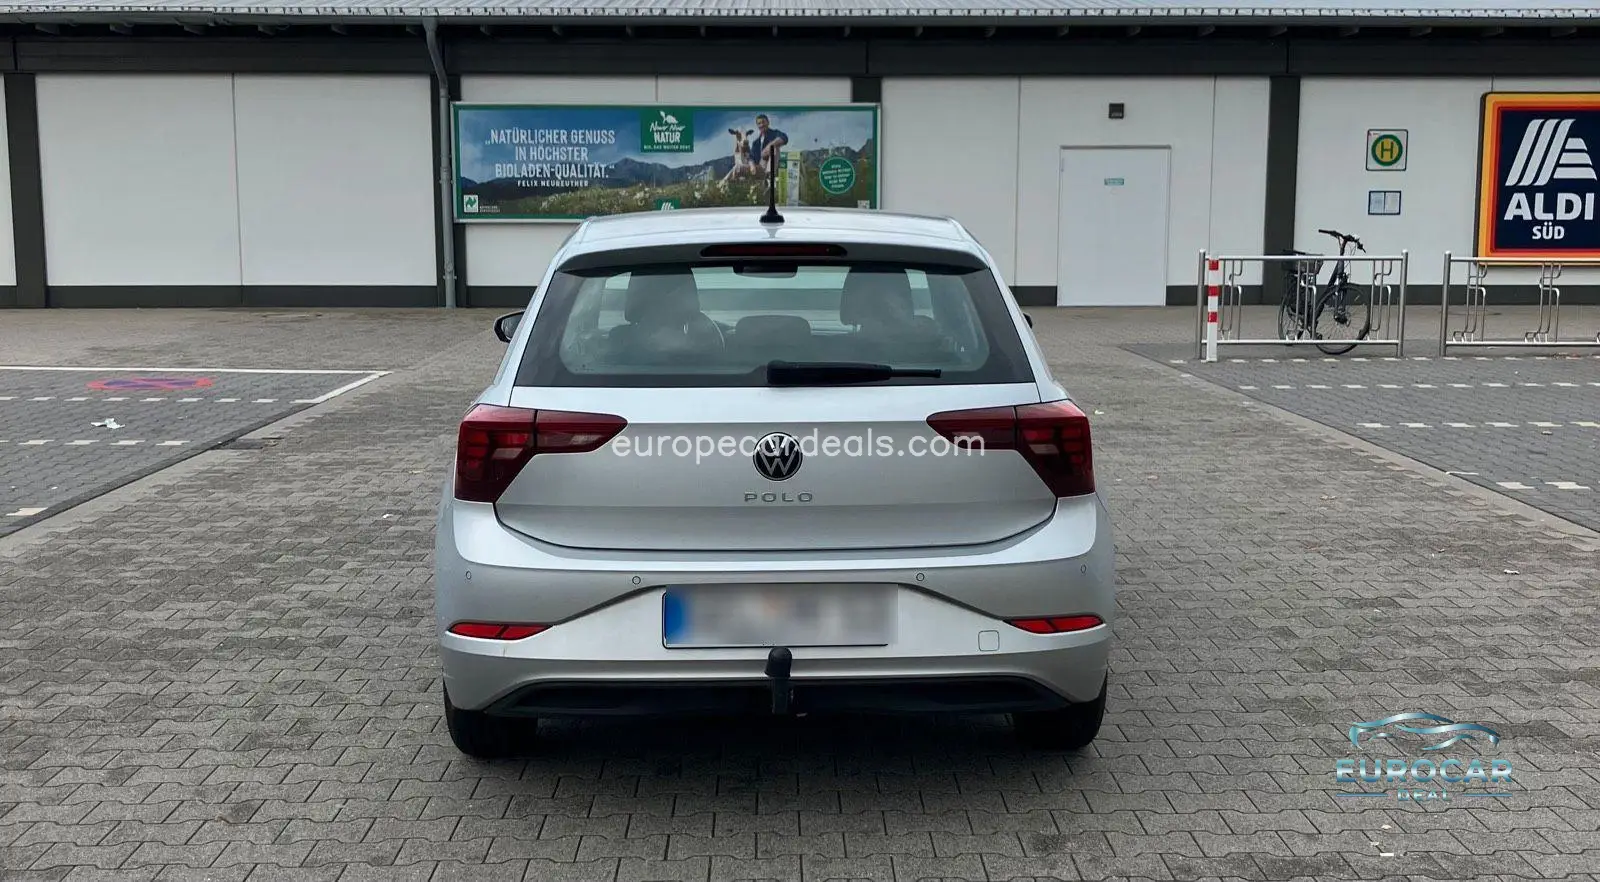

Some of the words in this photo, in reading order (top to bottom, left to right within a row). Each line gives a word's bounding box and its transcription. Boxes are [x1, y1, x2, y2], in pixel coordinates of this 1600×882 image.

[571, 129, 616, 144] GENUSS
[653, 131, 681, 143] NATUR
[515, 147, 529, 161] IN
[530, 146, 589, 161] HÖCHSTER
[1380, 141, 1395, 160] H
[1503, 192, 1596, 221] ALDI
[1531, 221, 1565, 240] SÜD
[743, 491, 813, 503] POLO
